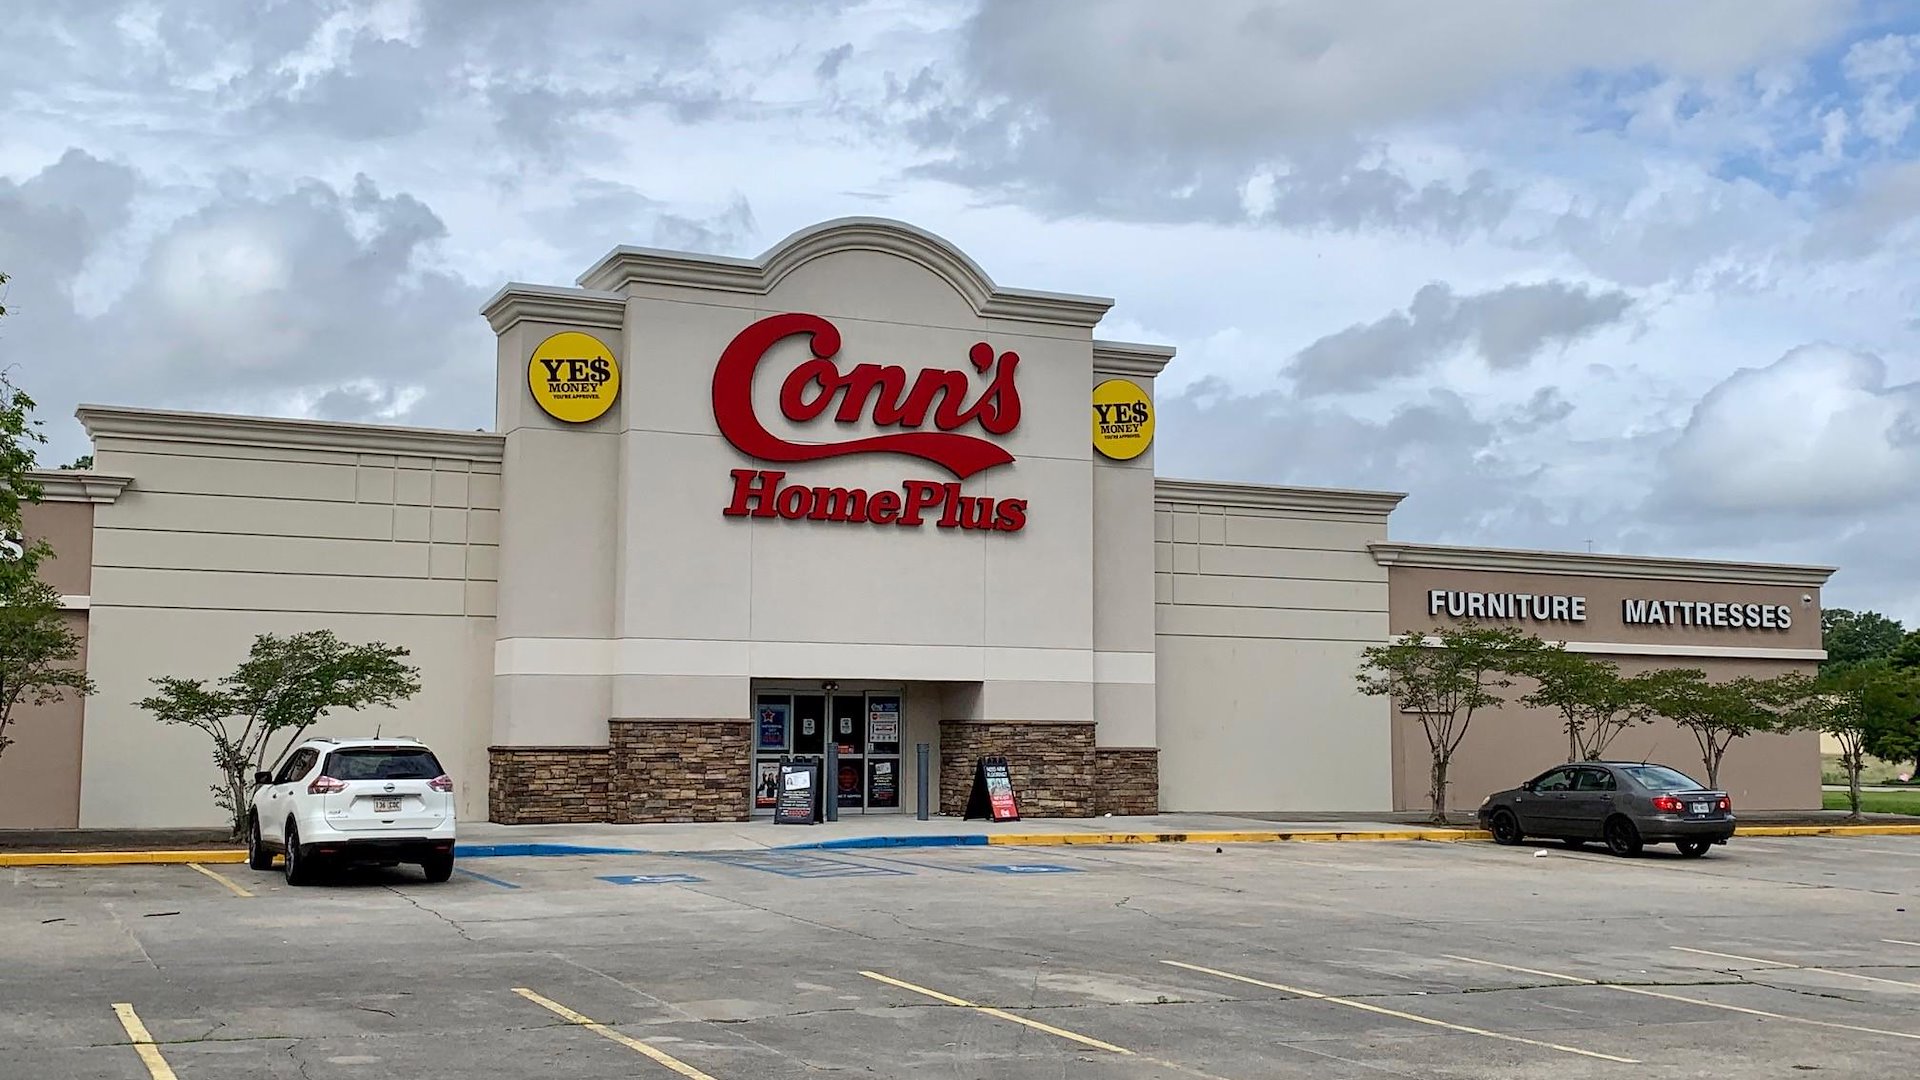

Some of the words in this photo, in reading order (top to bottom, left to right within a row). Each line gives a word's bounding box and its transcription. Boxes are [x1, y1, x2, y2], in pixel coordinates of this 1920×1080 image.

[539, 355, 611, 387] YE$
[548, 382, 598, 393] MONEY
[712, 312, 1021, 480] Conn's
[1093, 399, 1149, 427] YE$
[1100, 423, 1139, 434] MONEY
[723, 468, 1028, 532] HomePlus
[1428, 590, 1587, 621] FURNITURE
[1623, 599, 1793, 629] MATTRESSES
